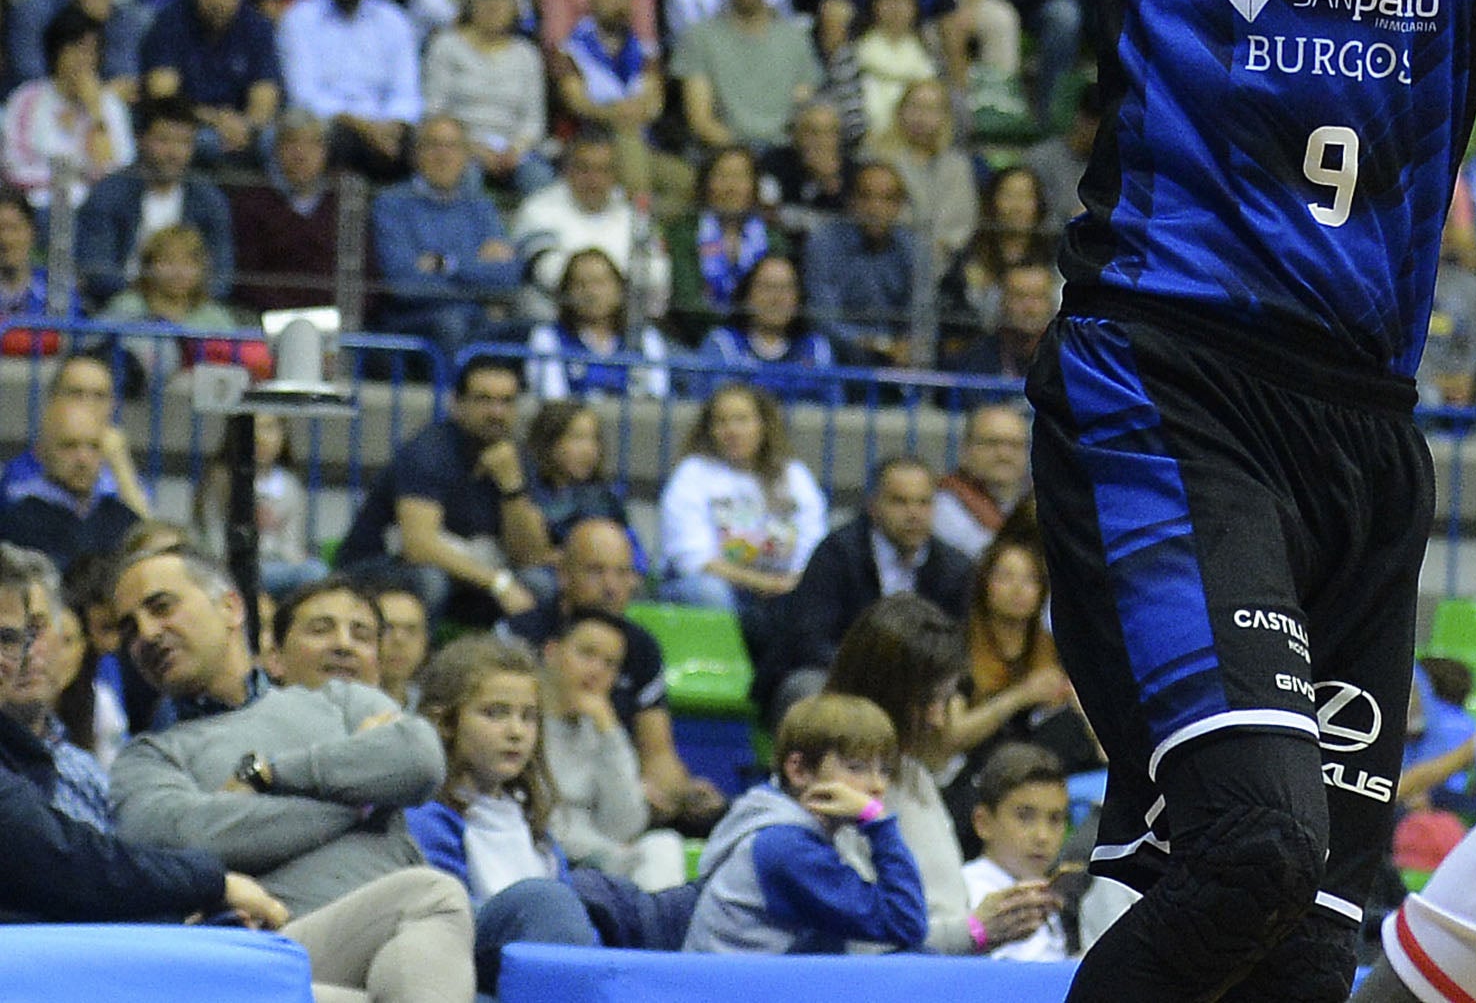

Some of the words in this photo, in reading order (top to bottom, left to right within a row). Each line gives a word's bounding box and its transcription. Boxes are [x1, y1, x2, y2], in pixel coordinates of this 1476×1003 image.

[1245, 35, 1412, 85] BURGOS
[1303, 126, 1359, 228] 9
[1233, 608, 1310, 648] CASTILL
[1321, 761, 1394, 804] XUS
